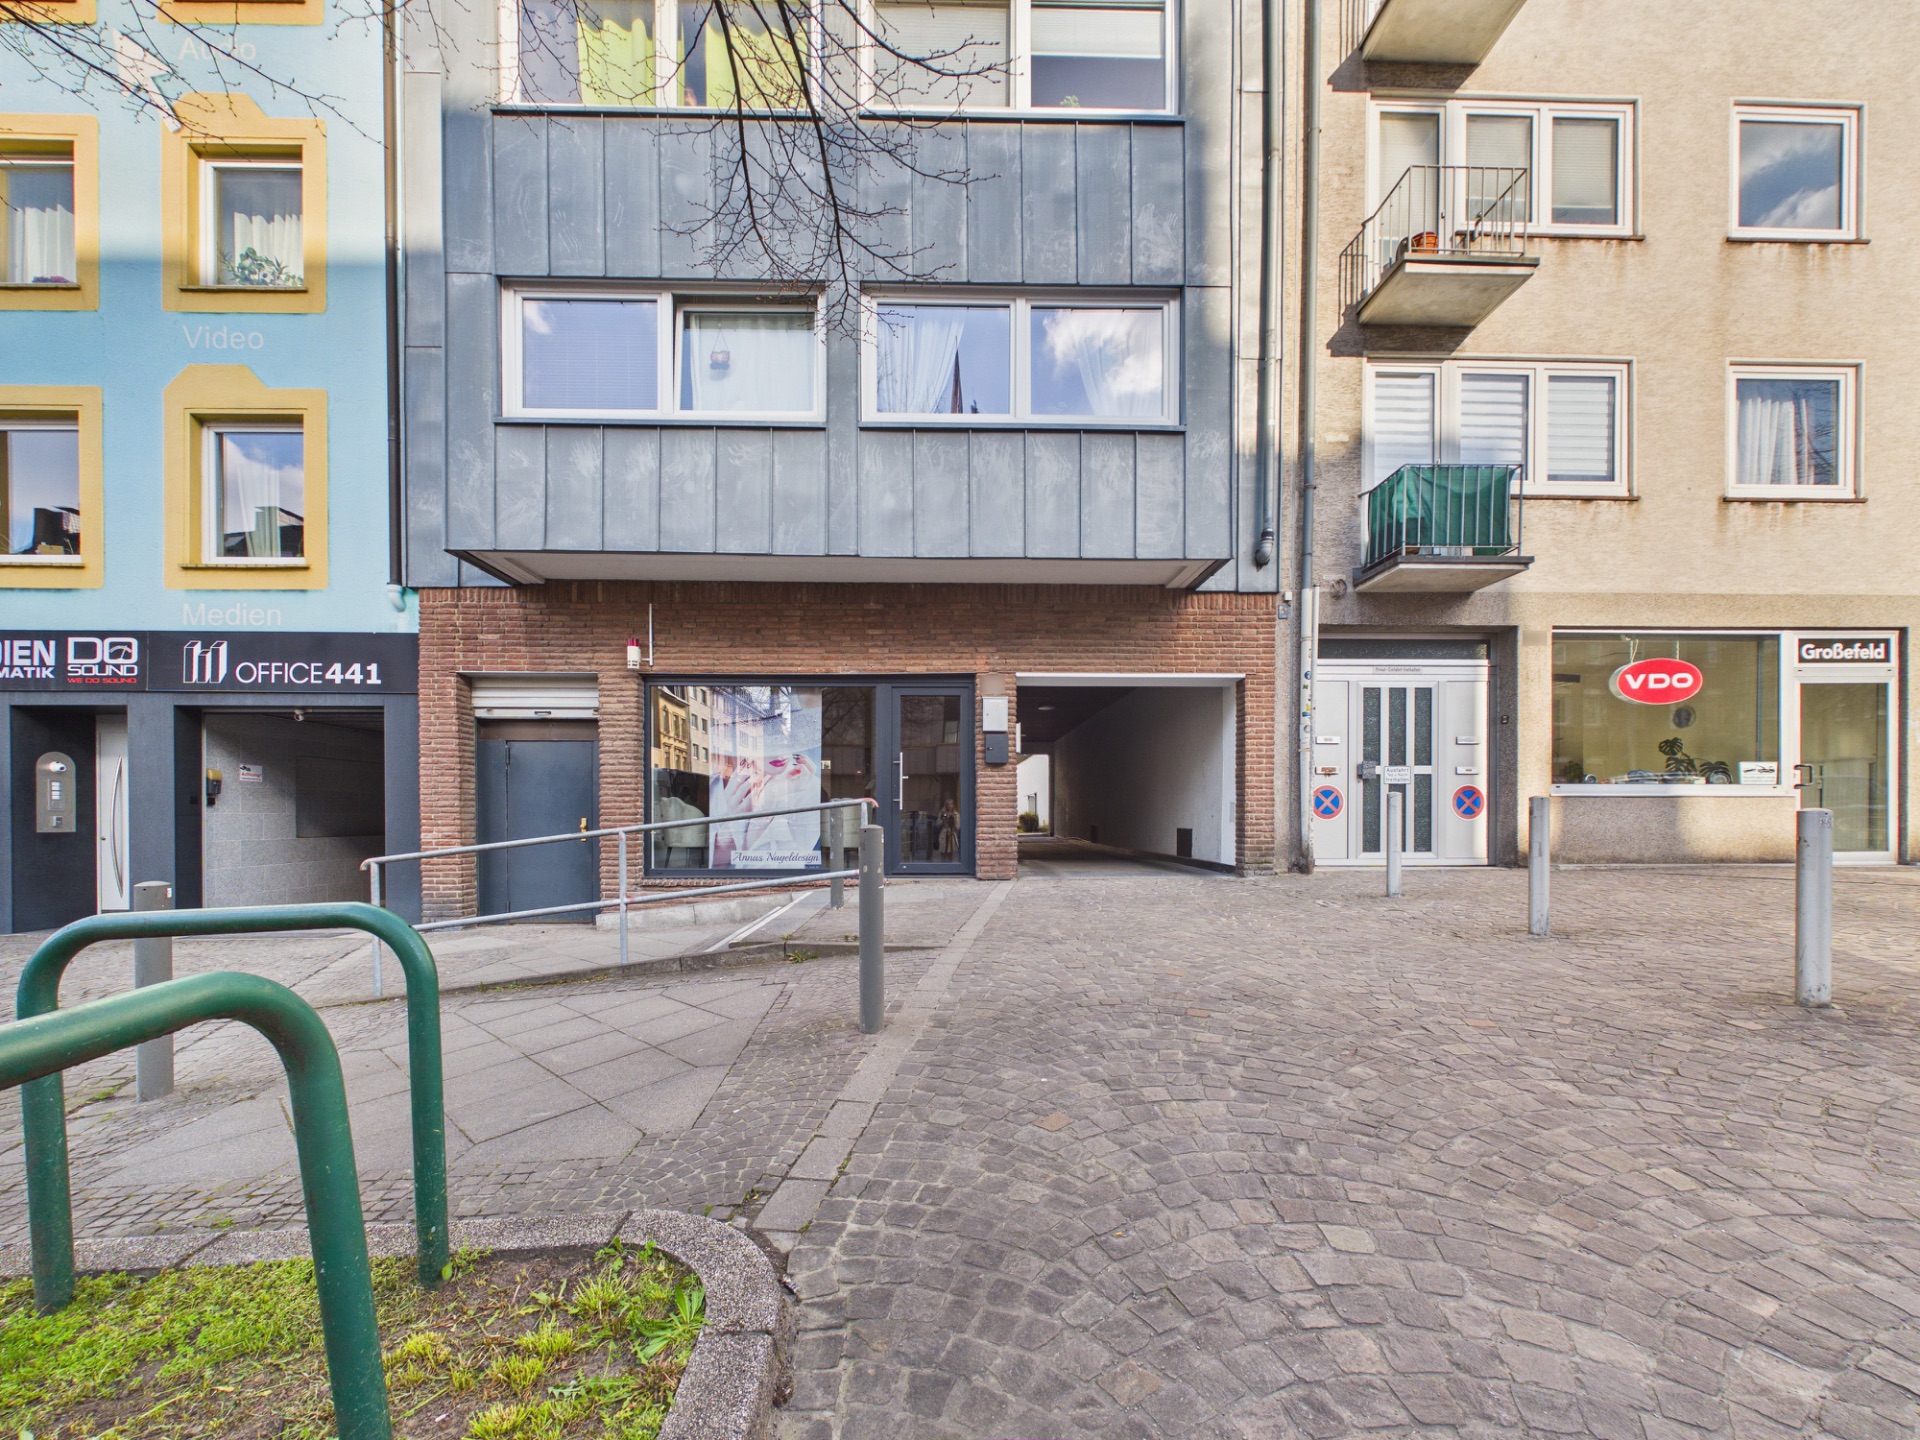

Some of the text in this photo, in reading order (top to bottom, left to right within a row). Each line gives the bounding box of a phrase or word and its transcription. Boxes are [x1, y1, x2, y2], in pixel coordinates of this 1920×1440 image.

[178, 37, 257, 61] Audio
[182, 325, 264, 350] Video
[182, 603, 281, 626] Medien
[0, 640, 56, 666] IEN
[1801, 642, 1886, 660] Großefeld
[67, 664, 138, 676] SOUND
[235, 662, 381, 684] OFFICE441
[1624, 672, 1693, 690] VDO
[733, 852, 819, 864] Annas Nageldesign
